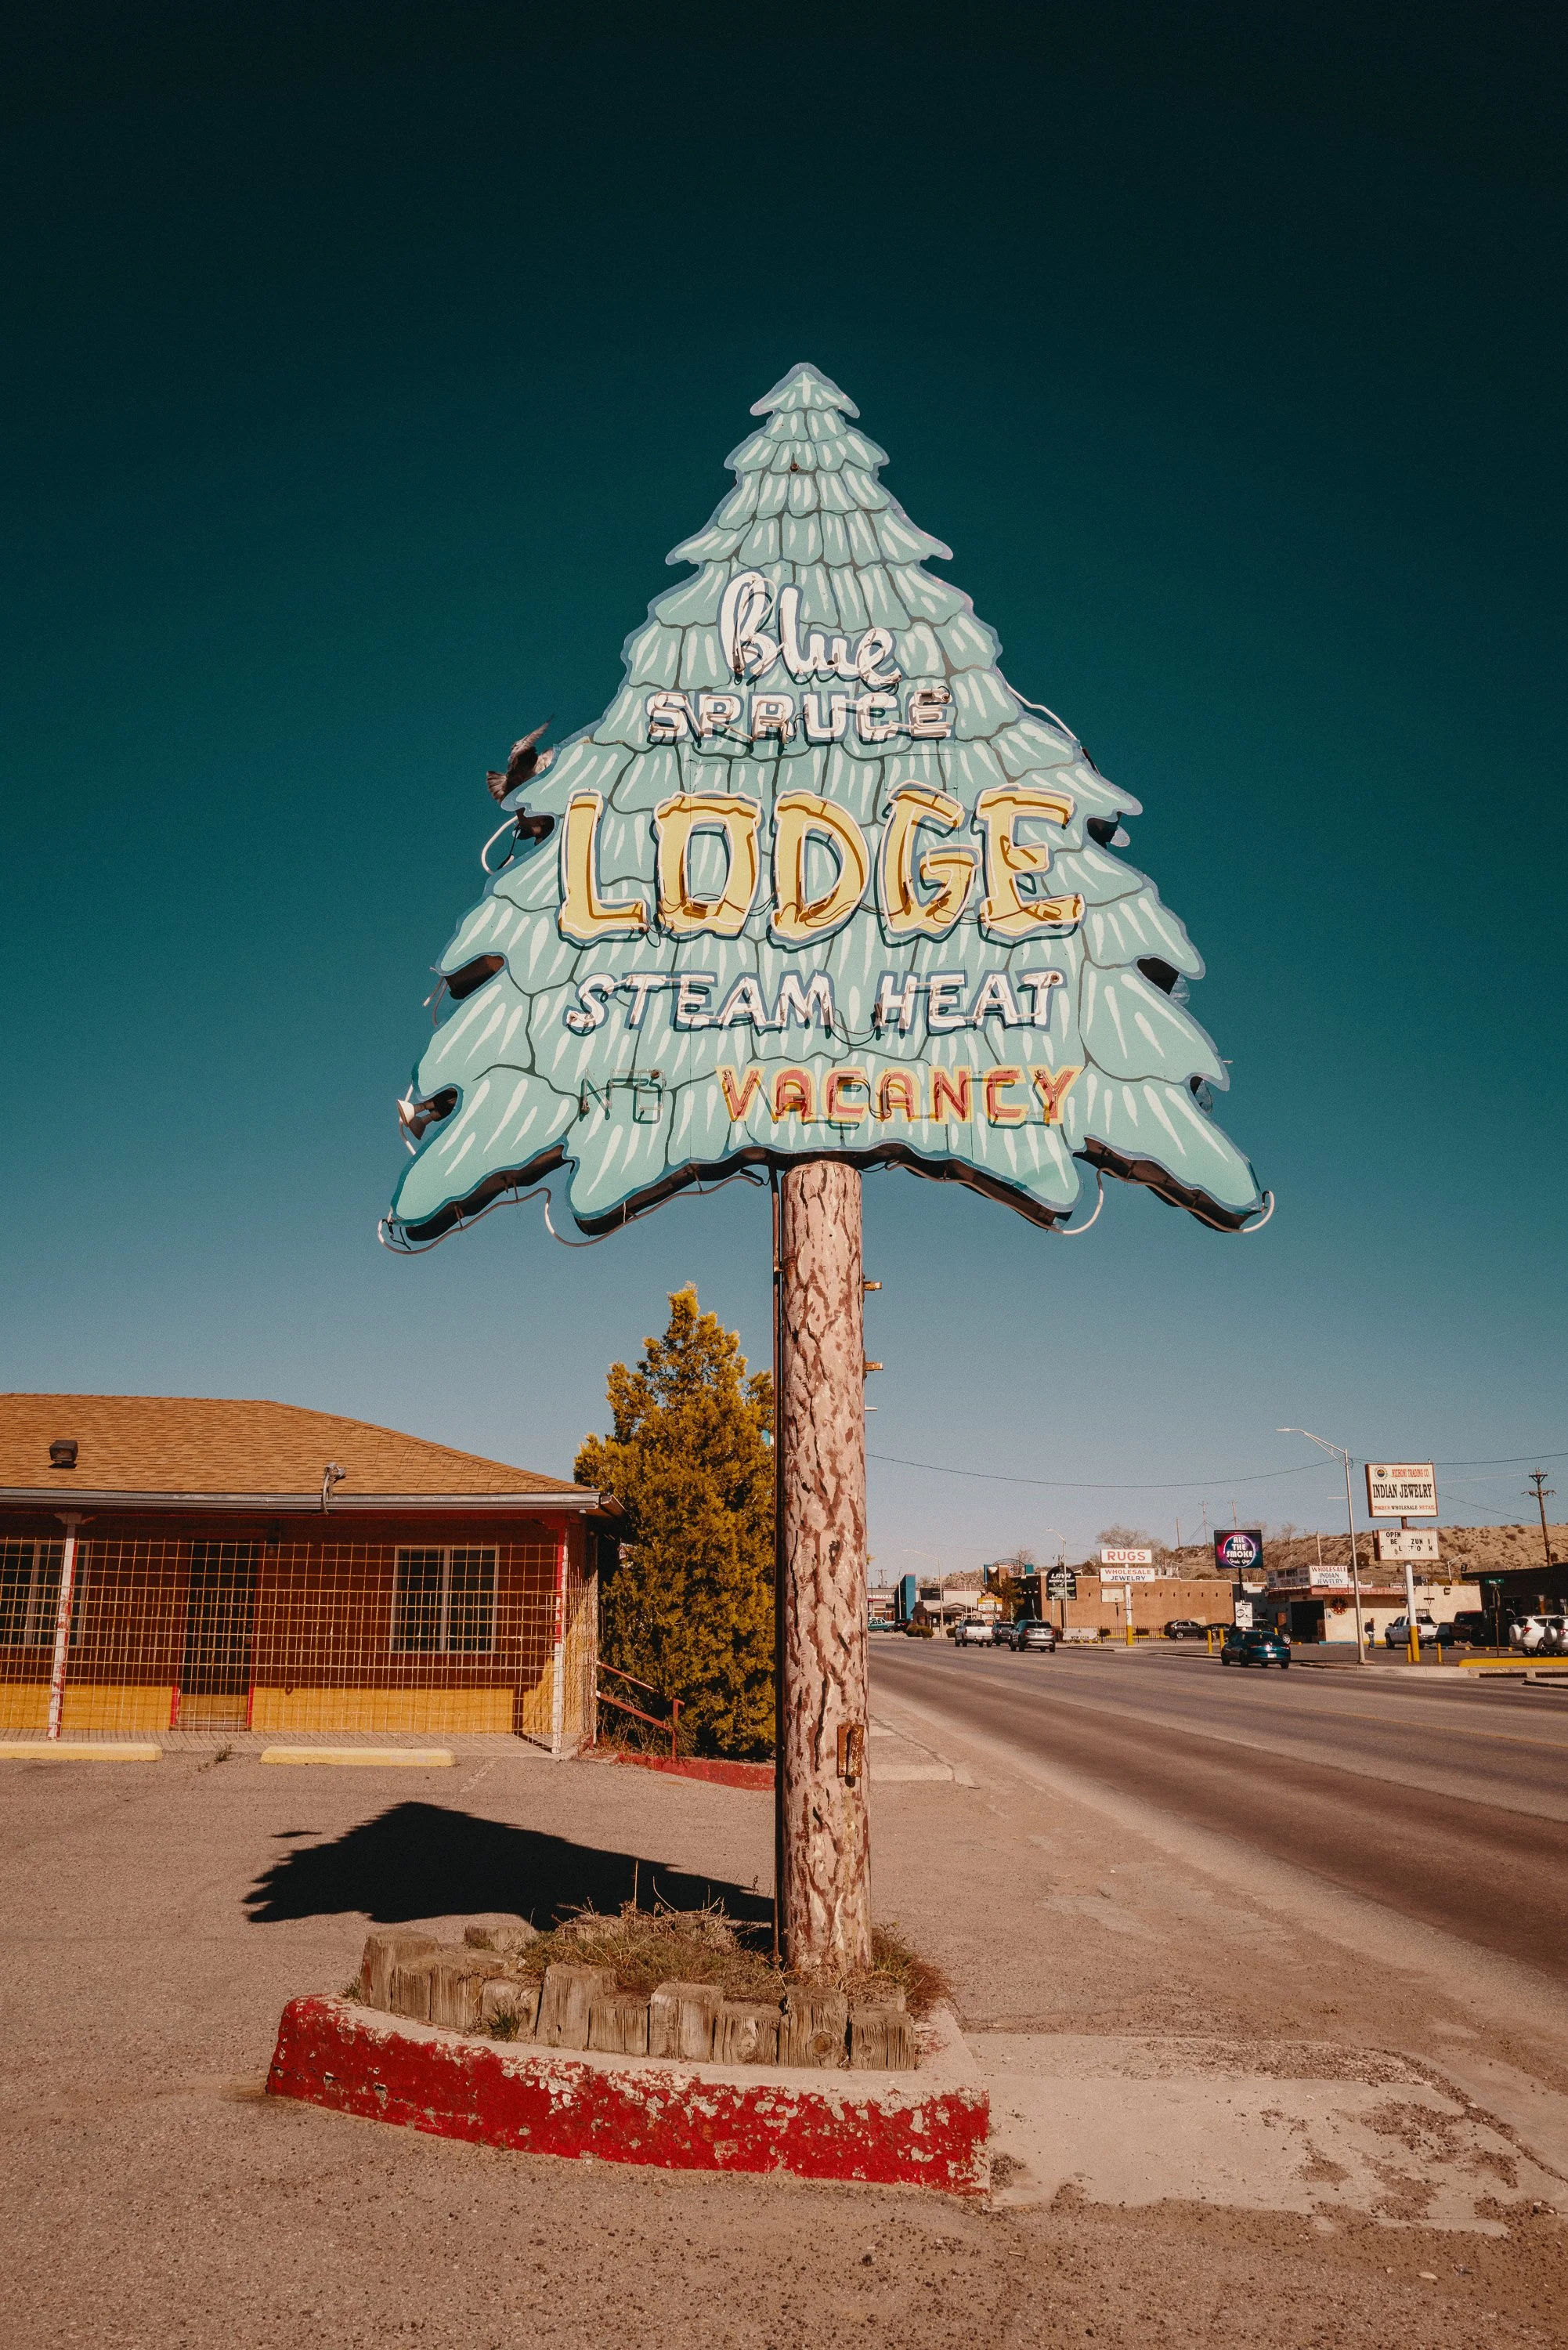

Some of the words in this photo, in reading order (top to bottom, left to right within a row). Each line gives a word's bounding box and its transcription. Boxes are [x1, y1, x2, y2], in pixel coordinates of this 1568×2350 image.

[720, 570, 902, 686] Blue
[645, 690, 952, 742] SPRUCE
[558, 782, 1085, 938] LODGE
[567, 972, 833, 1028] STEAM
[879, 972, 1062, 1028] HEAT
[580, 1068, 667, 1116] NO
[716, 1065, 1086, 1123] VACANCY
[1373, 1484, 1397, 1498] INDIAN
[1400, 1484, 1433, 1498] JEWELRY
[1107, 1551, 1146, 1561] RUGS
